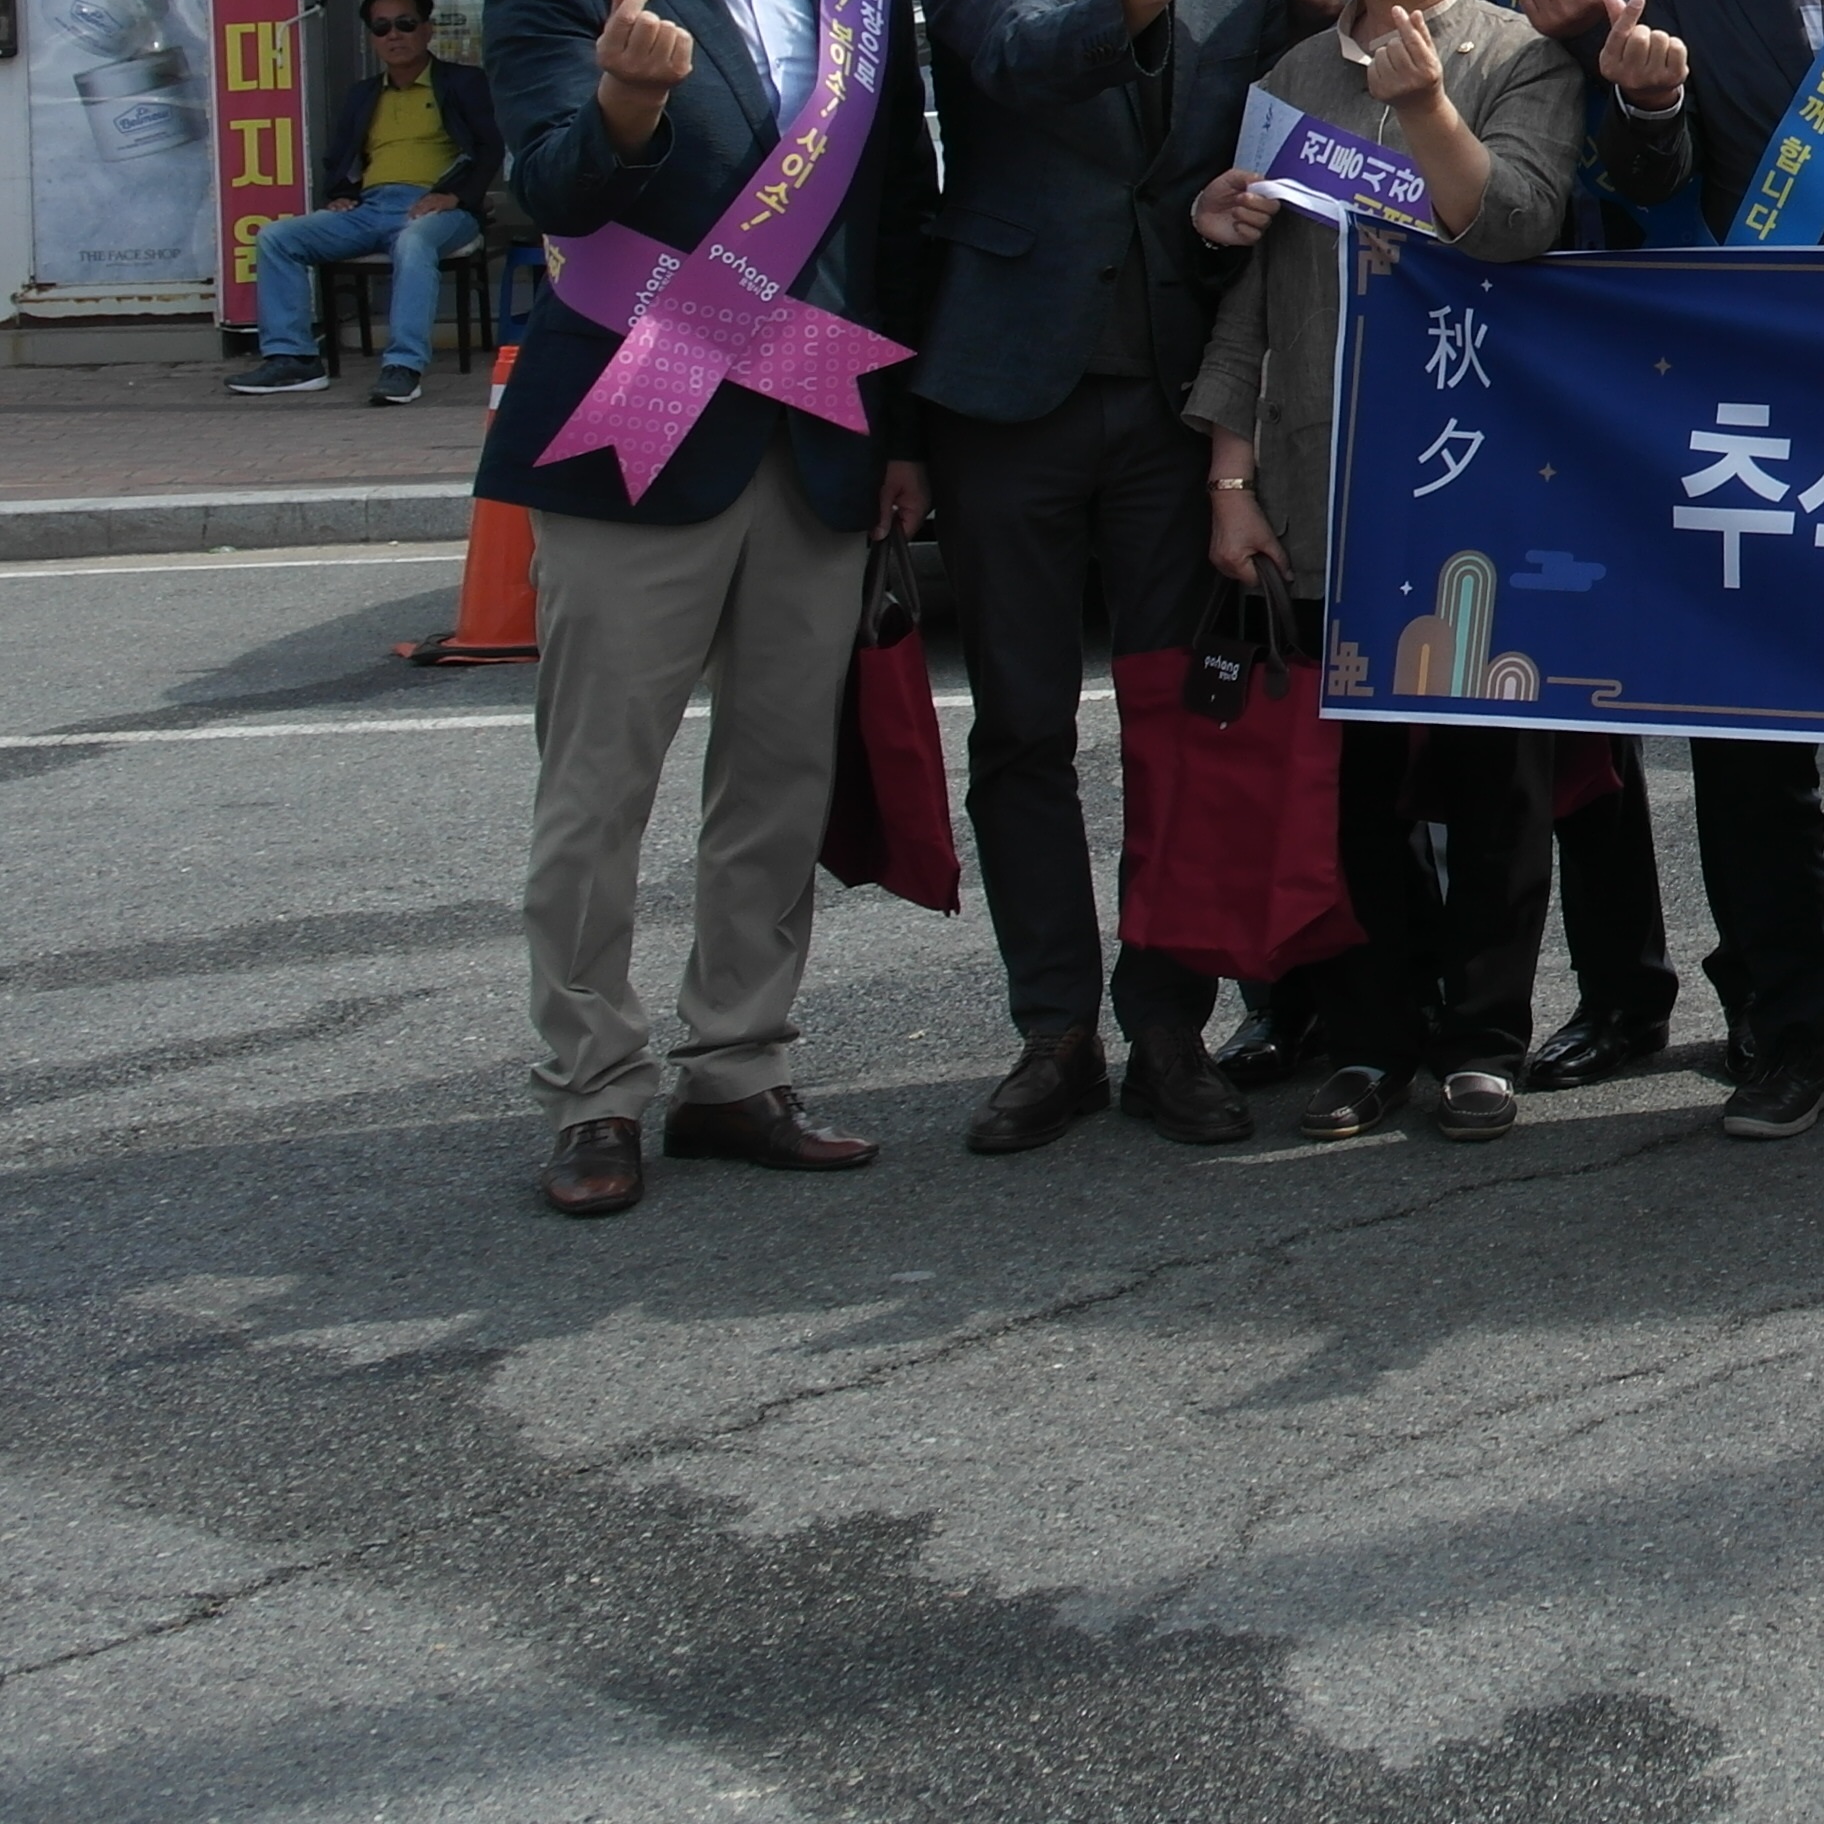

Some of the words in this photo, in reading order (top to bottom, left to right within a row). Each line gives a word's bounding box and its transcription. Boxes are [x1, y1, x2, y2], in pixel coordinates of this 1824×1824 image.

[740, 127, 828, 232] 사이소!
[1300, 130, 1427, 205] 전통시장
[1742, 136, 1814, 242] 합니다
[79, 249, 106, 262] THE
[108, 249, 140, 262] FACE
[1414, 302, 1494, 502] 秋夕
